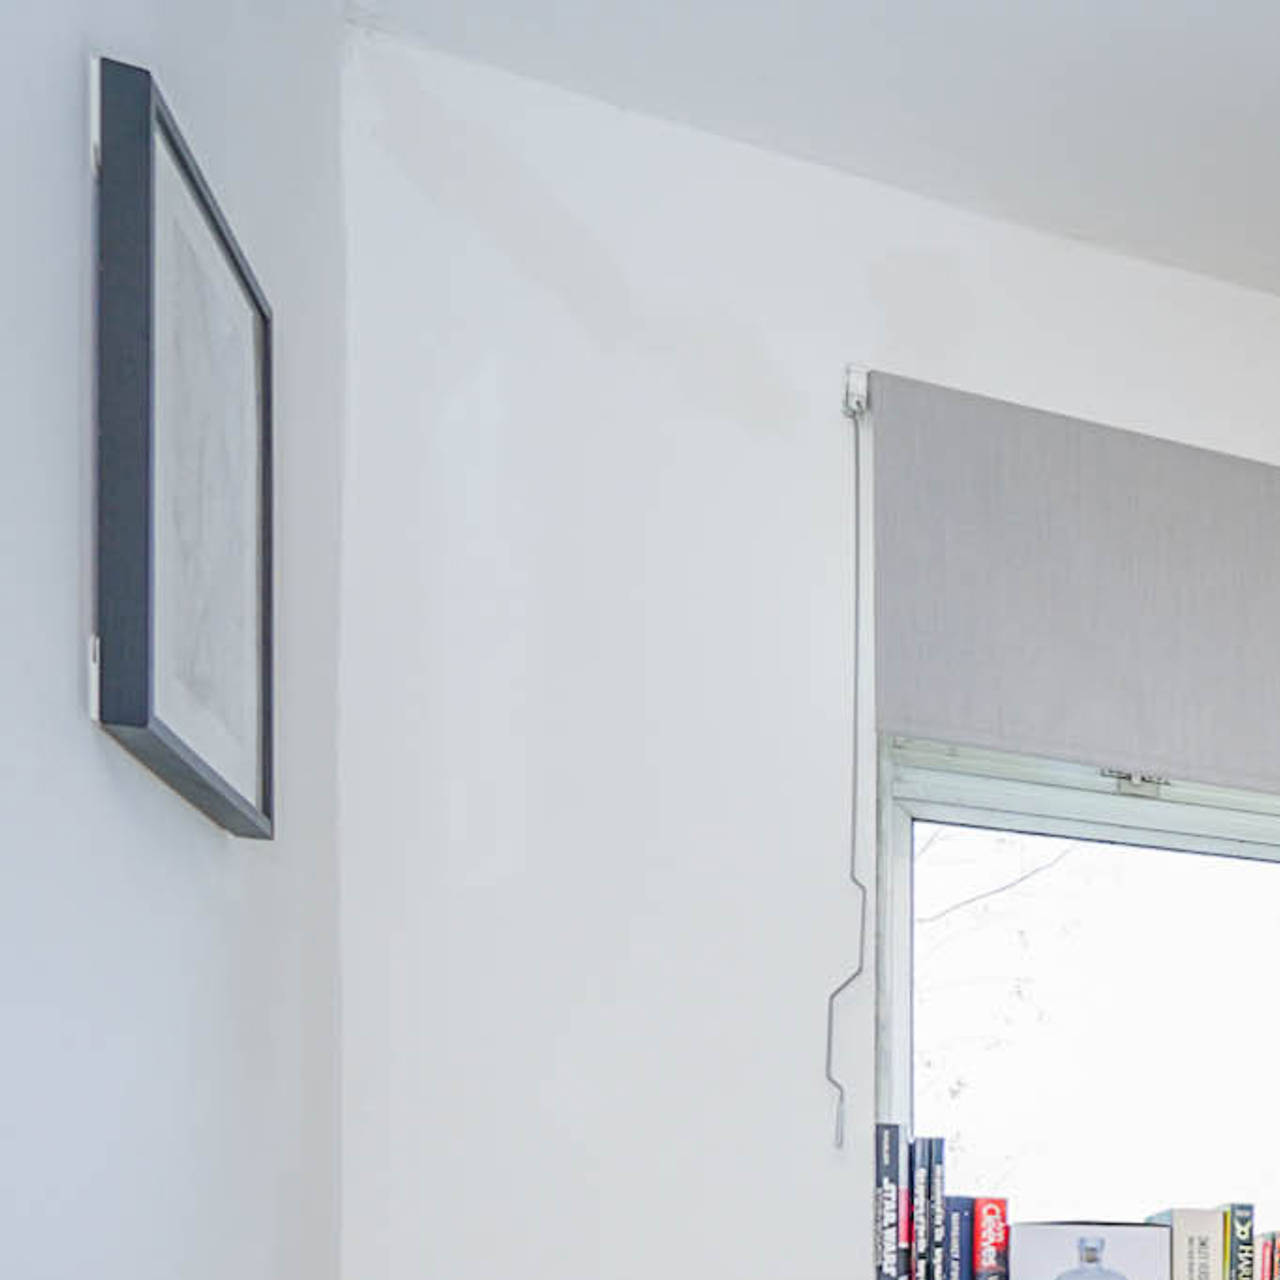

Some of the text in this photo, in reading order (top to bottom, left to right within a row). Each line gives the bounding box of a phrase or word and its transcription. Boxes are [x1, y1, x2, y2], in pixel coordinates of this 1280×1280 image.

[882, 1177, 897, 1277] STAR WARS
[980, 1203, 999, 1268] Cleeves
